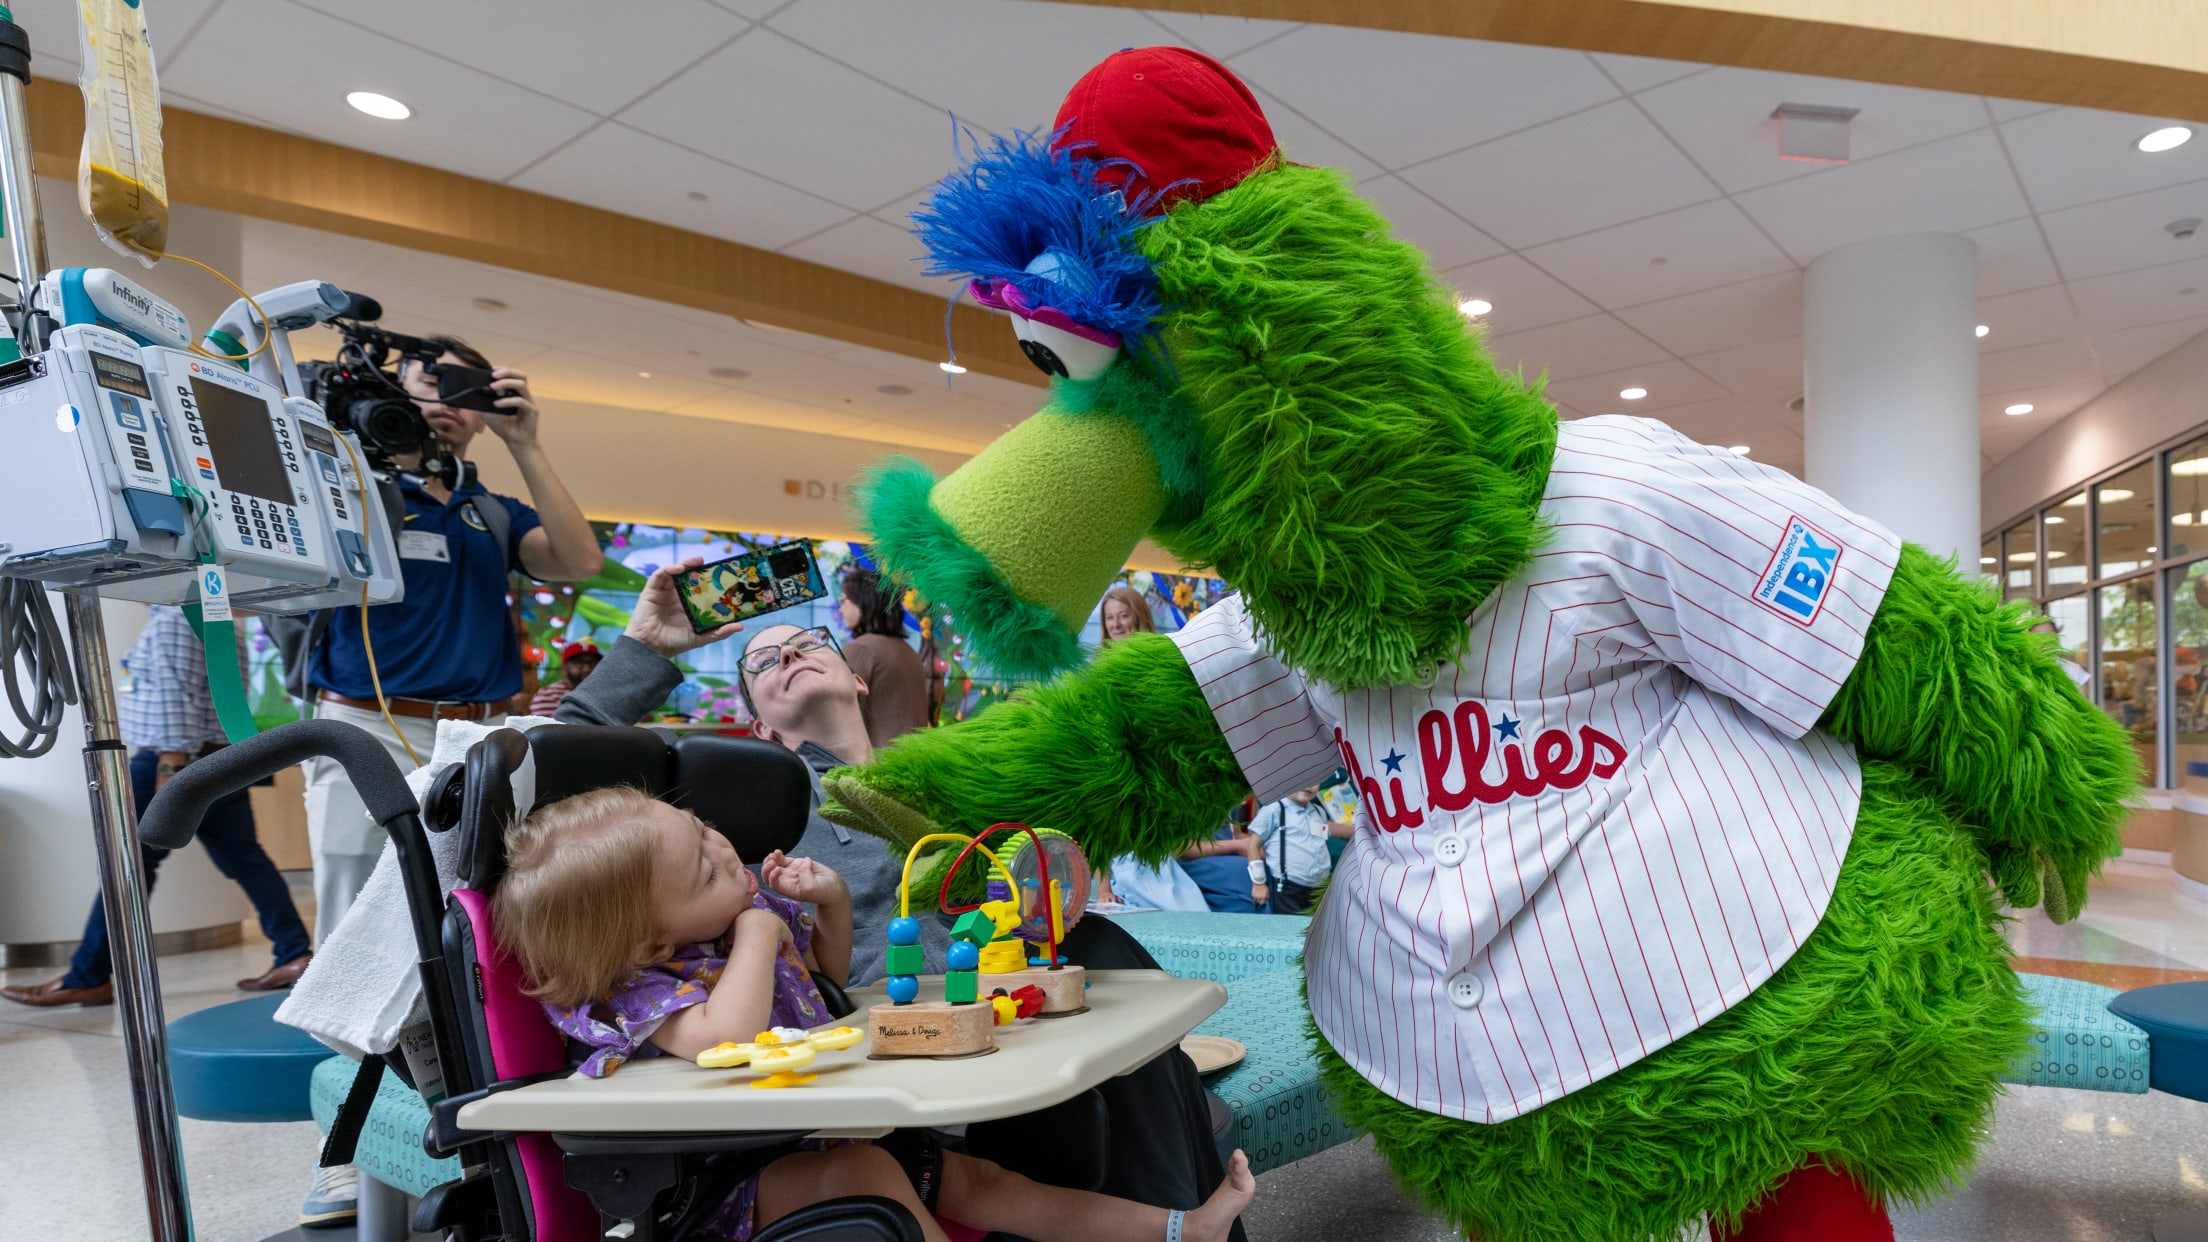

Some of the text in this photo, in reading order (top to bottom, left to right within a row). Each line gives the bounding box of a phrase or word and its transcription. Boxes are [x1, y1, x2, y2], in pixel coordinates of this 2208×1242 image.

[113, 281, 150, 315] Infinity
[201, 366, 214, 377] BD
[244, 380, 260, 393] PCU
[1760, 533, 1799, 598] Independence
[1773, 531, 1837, 617] IBX
[207, 574, 220, 593] K
[1334, 700, 1628, 835] hillies
[878, 1025, 910, 1039] Melissa
